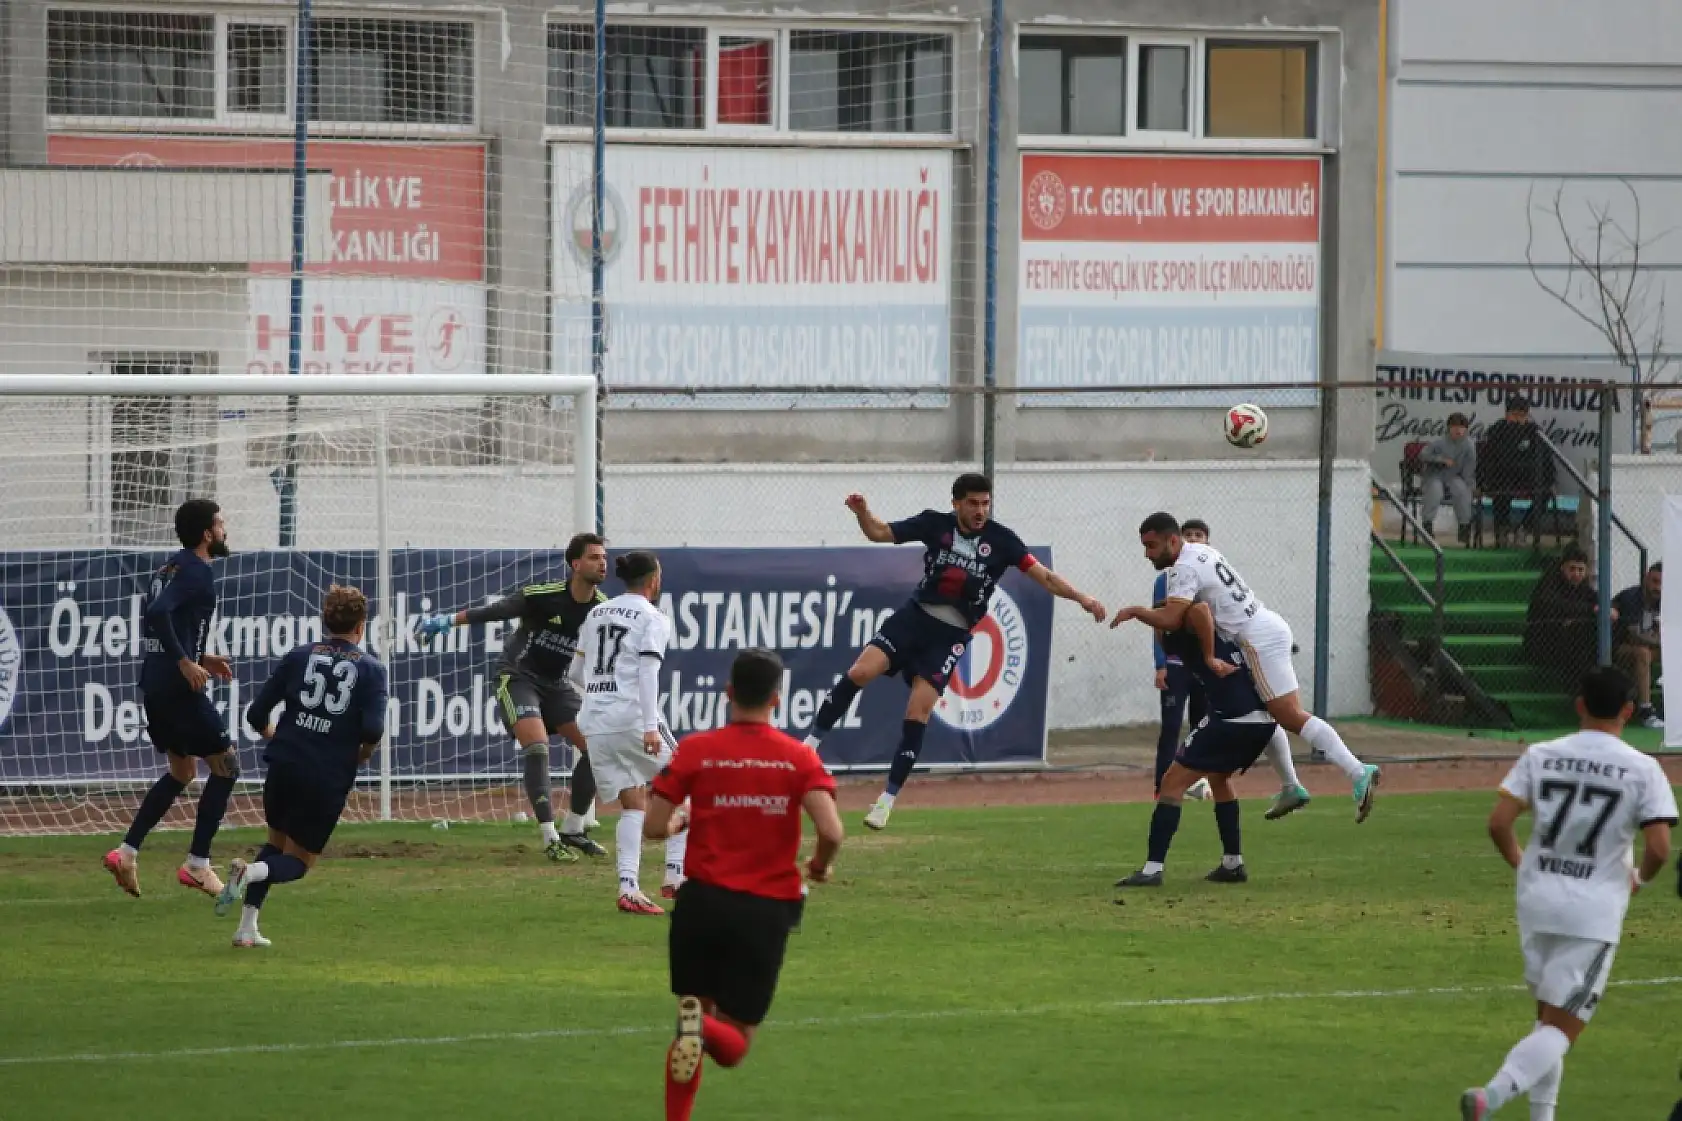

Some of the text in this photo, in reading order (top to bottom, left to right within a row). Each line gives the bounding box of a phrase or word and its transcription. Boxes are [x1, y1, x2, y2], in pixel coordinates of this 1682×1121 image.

[386, 175, 422, 208] VE
[1071, 181, 1314, 224] T.C. GENÇLİK VE SPOR BAKANLIĞI
[639, 165, 939, 283] FETHİYE KAYMAKAMLIĞI
[1026, 253, 1315, 300] FETHİYE GENÇLİK VE SPOR İLÇE MÜDÜRLÜĞÜ
[1026, 312, 1092, 383] FETHİYE
[49, 582, 140, 657] Özel
[593, 622, 631, 675] 17
[300, 654, 358, 714] 53
[1542, 758, 1628, 780] ESTENET
[1539, 779, 1623, 858] 77
[1537, 855, 1597, 880] YUSUF
